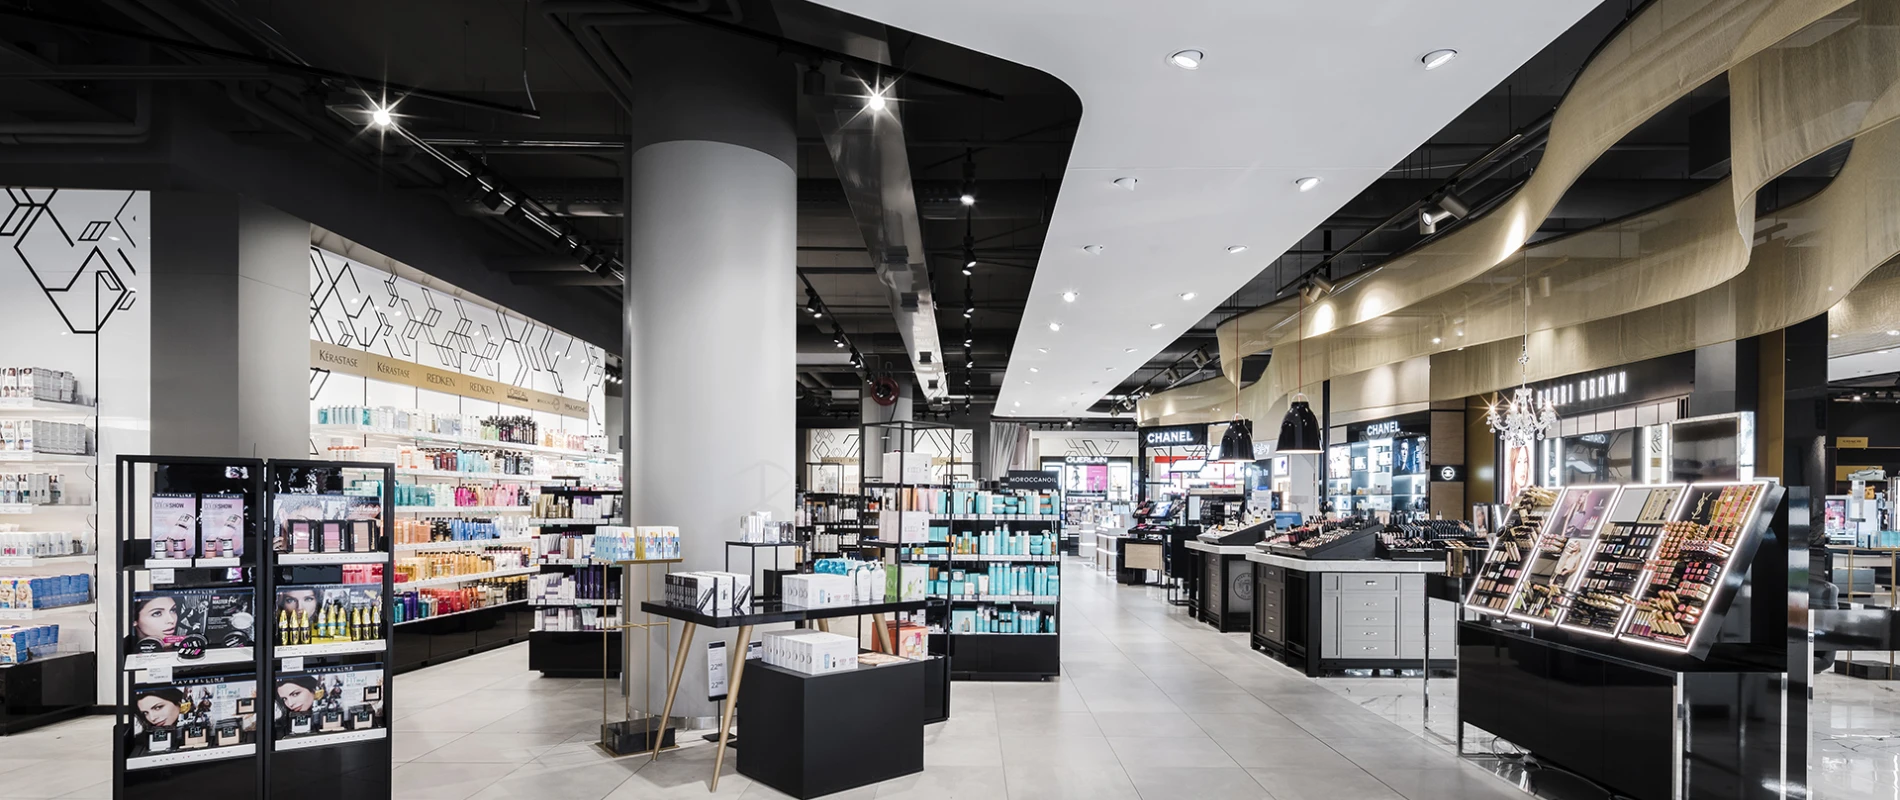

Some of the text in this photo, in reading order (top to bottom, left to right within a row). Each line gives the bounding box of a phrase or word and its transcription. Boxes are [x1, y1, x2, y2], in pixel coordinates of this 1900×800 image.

[319, 349, 358, 367] KÉRASTASE
[377, 361, 410, 379] KÉRASTASE
[426, 372, 456, 387] REDKEN
[1580, 371, 1626, 401] BROWN
[469, 382, 495, 395] REDKEN
[1366, 421, 1400, 436] CHANEL
[1147, 431, 1194, 443] CHANEL
[171, 677, 225, 685] MAYBELLINE
